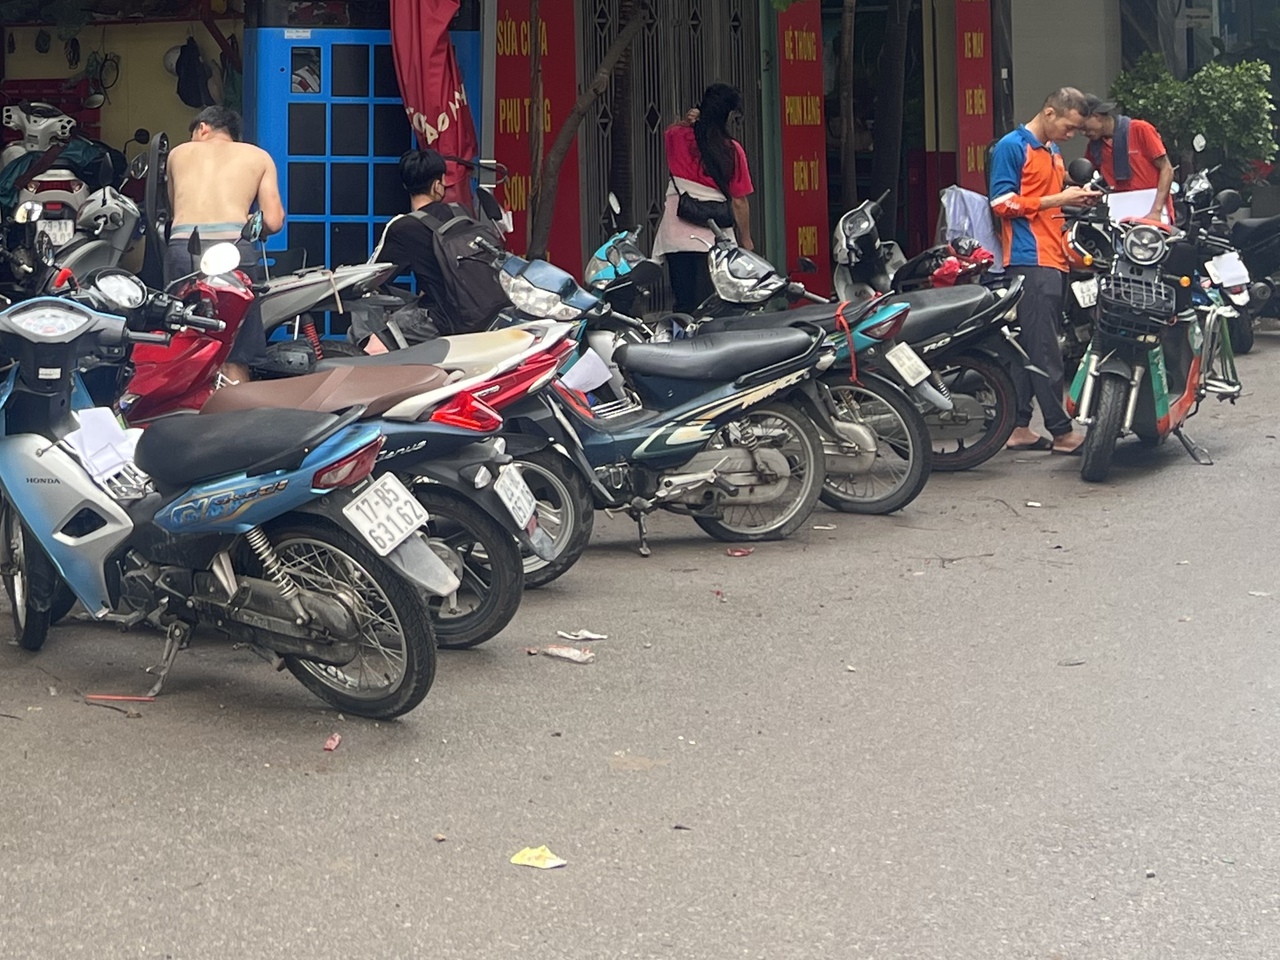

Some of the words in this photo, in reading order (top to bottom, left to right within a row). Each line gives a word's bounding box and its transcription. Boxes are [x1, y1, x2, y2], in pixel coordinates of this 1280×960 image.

[497, 9, 518, 57] SỬA
[521, 18, 548, 57] CA
[499, 98, 520, 140] PHỤ
[524, 98, 551, 133] TG
[355, 481, 400, 524] 17-B5
[368, 500, 424, 549] 631.62
